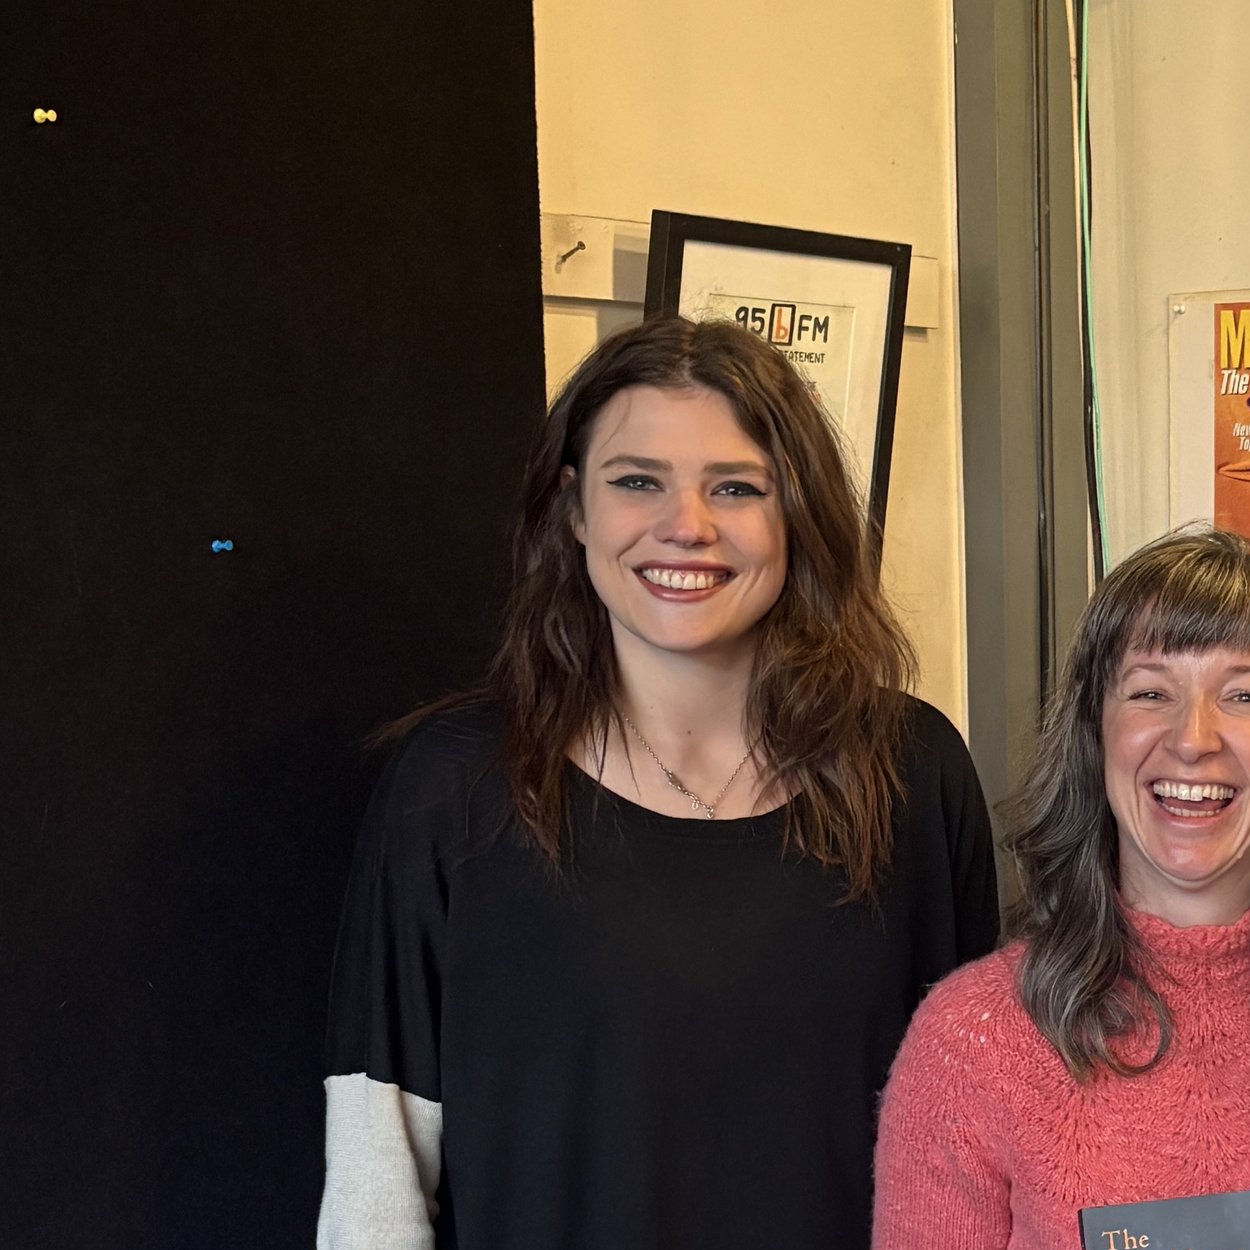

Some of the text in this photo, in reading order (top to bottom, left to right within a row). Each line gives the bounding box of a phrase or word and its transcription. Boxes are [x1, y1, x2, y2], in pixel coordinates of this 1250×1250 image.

[797, 314, 830, 344] FM
[782, 350, 826, 364] TATEMENT
[1220, 370, 1249, 395] The
